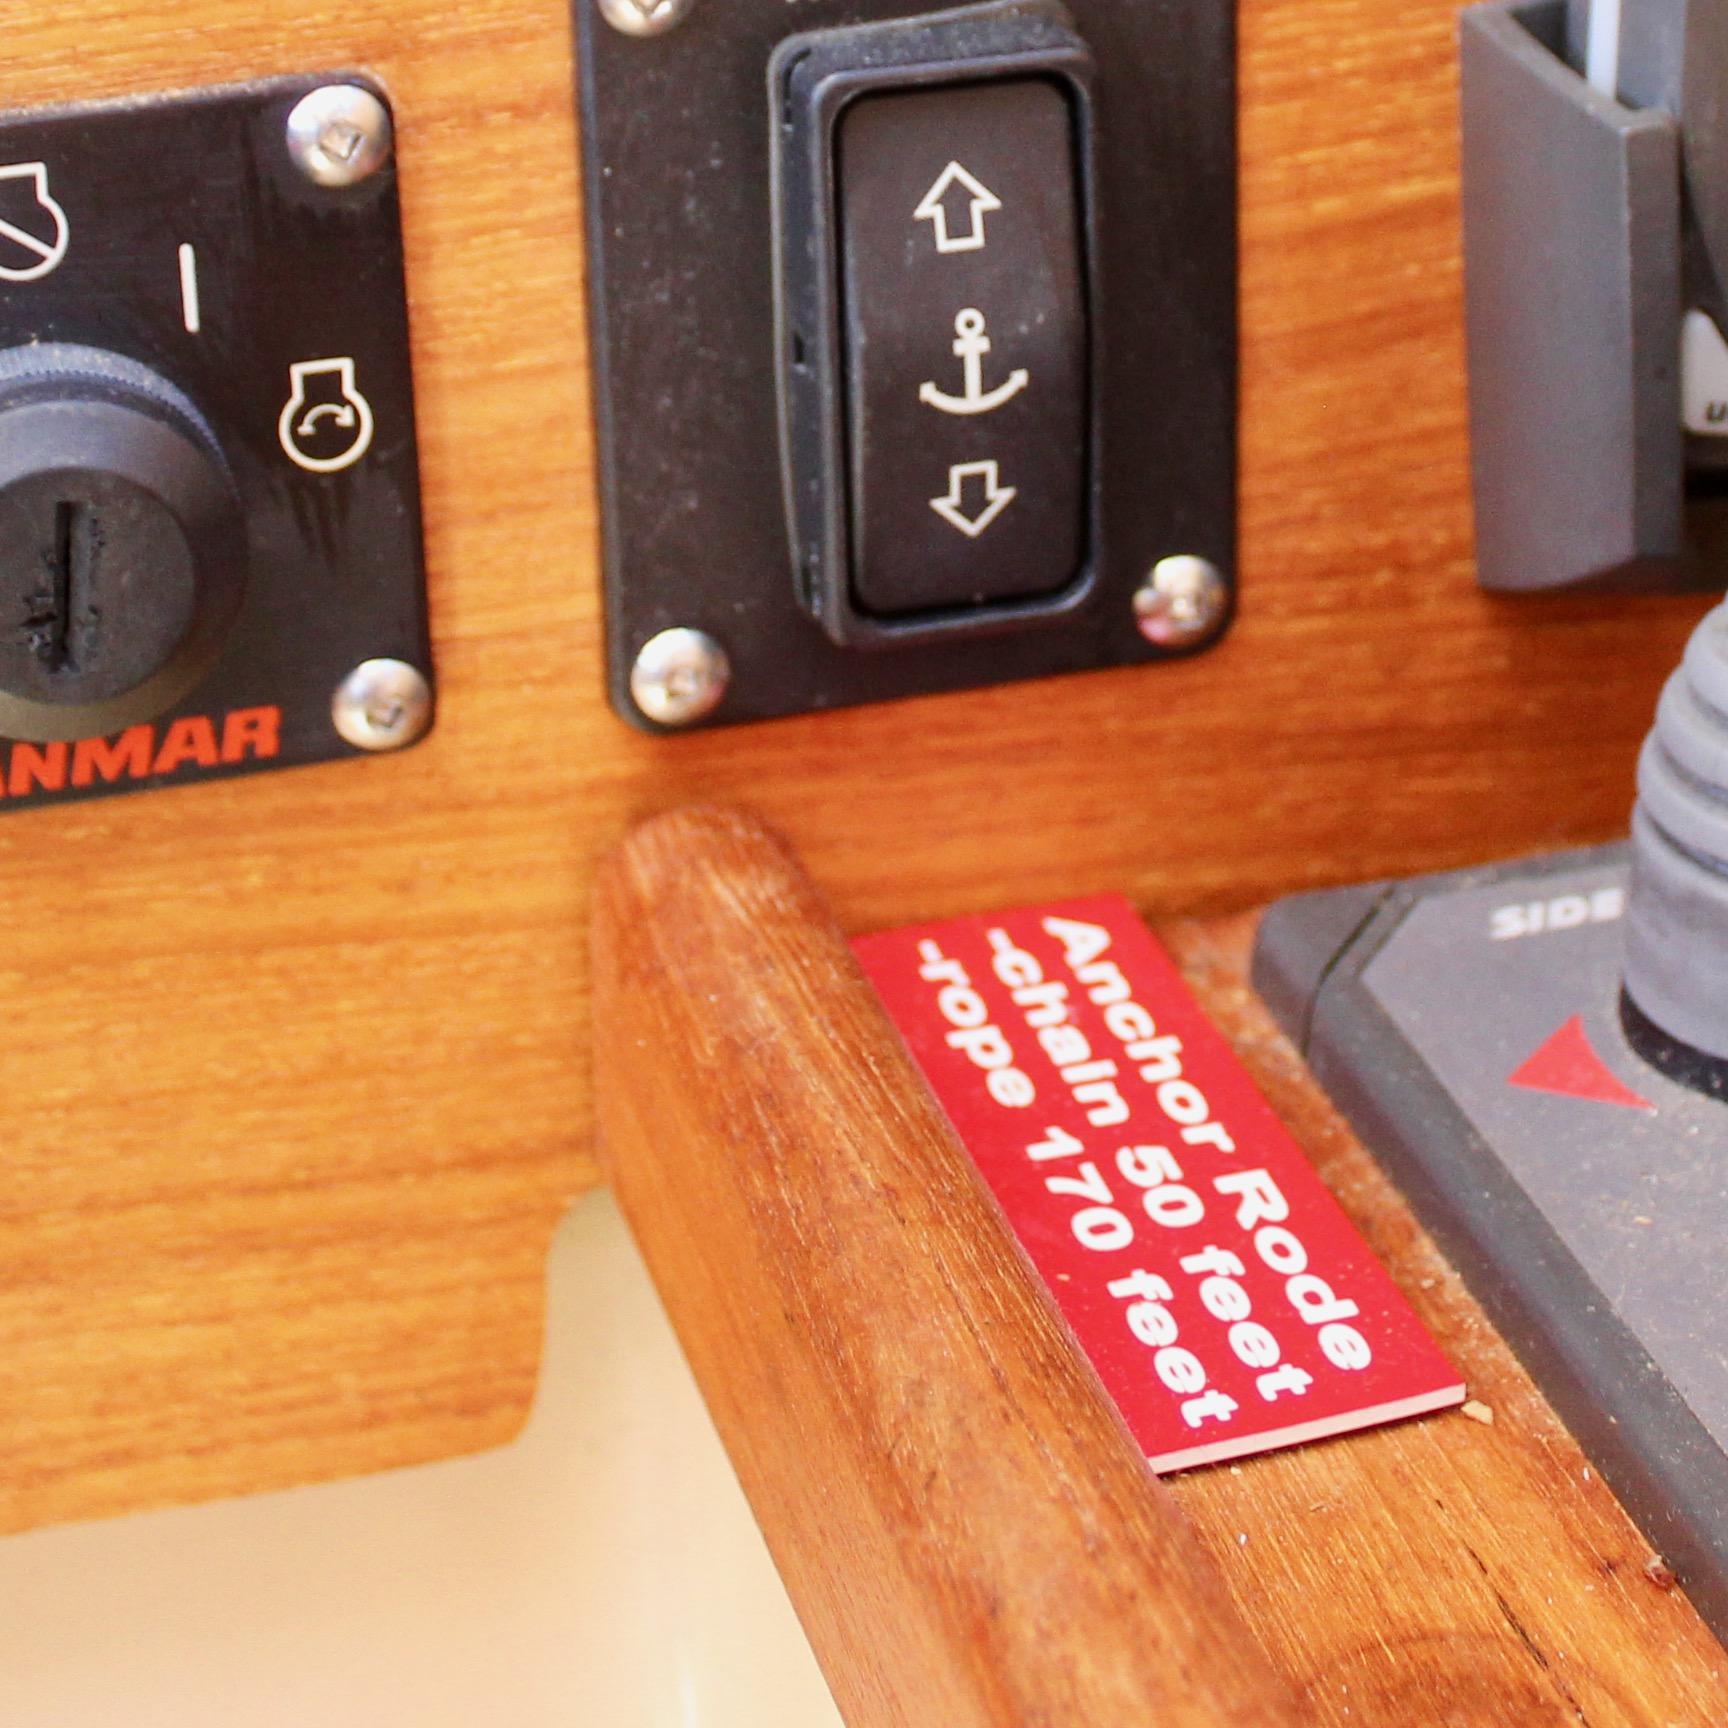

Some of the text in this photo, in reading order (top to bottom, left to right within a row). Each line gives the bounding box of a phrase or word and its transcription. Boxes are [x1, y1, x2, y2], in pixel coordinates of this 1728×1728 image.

[918, 938, 1239, 1428] -rope 170 feet
[987, 927, 1314, 1402] -chain 50 feet
[1041, 915, 1373, 1371] Anchor Rode
